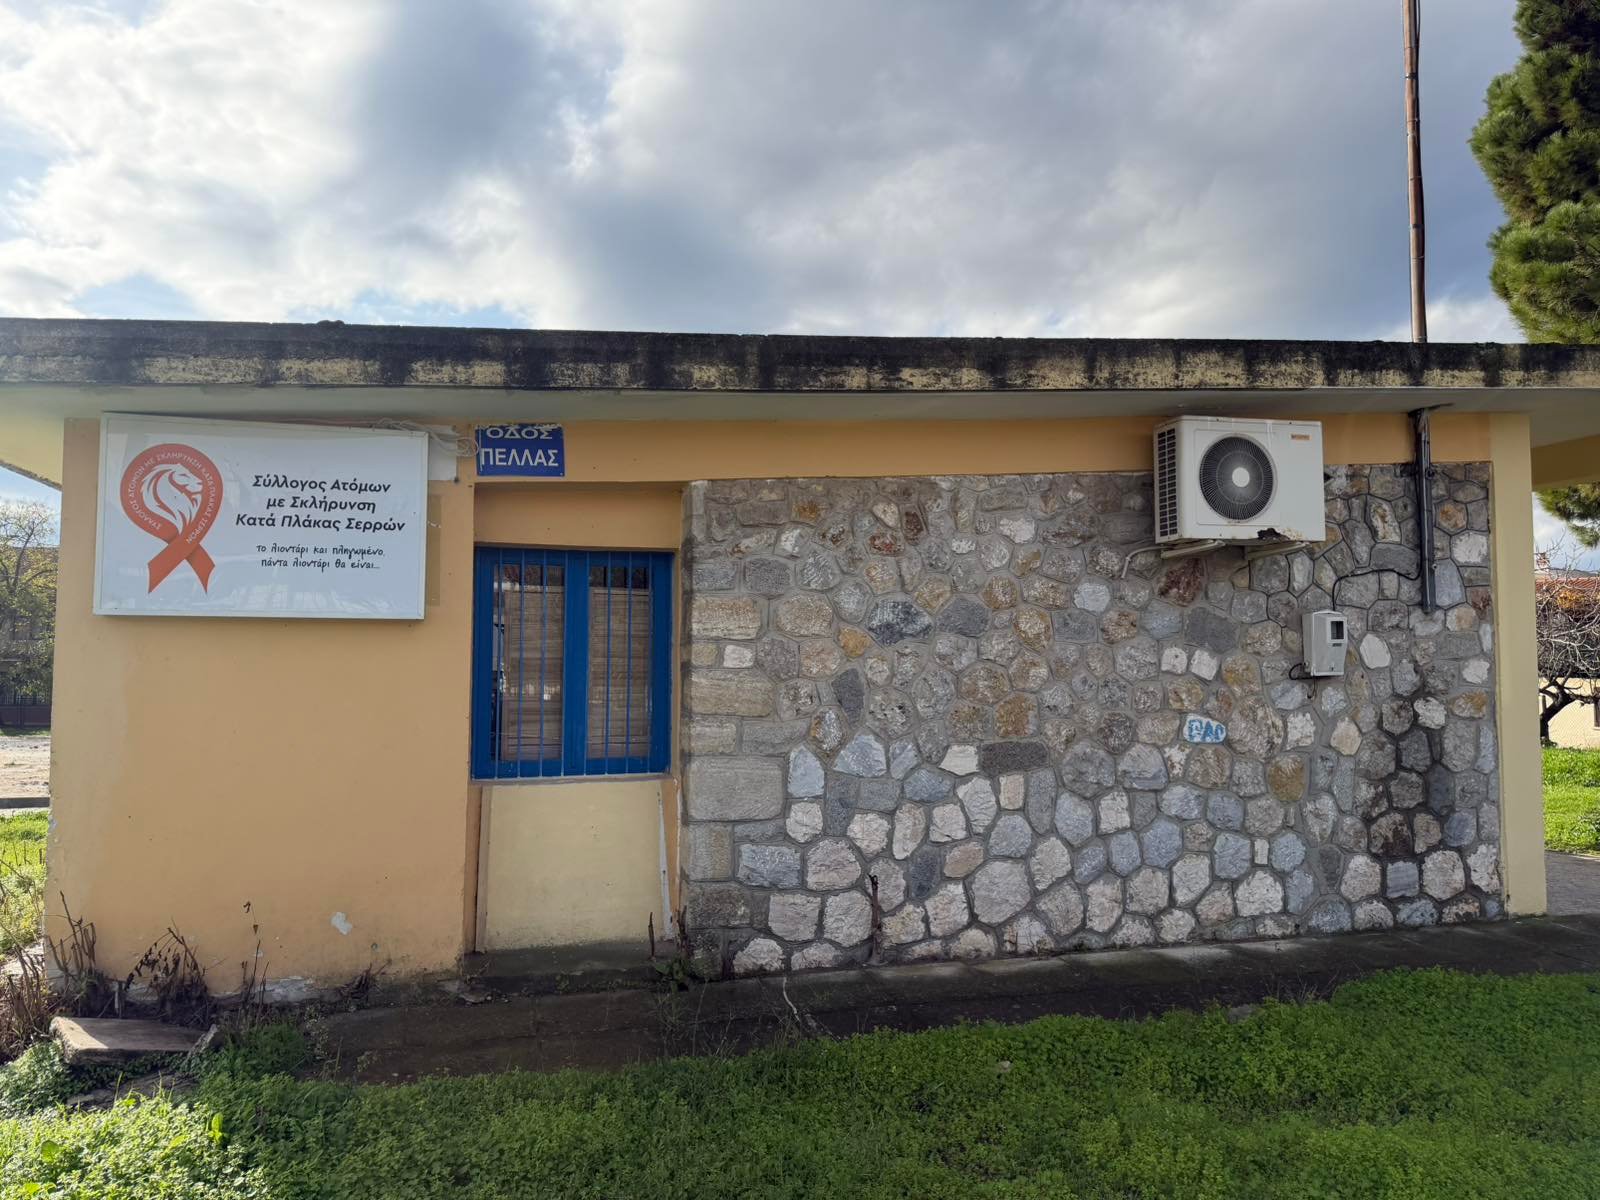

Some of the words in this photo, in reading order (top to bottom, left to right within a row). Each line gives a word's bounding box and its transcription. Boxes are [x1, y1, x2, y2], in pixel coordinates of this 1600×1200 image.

[486, 426, 553, 439] ΟΔΟΣ
[481, 448, 559, 467] ΠΕΛΛΑΣ
[252, 474, 327, 493] Σύλλογος
[330, 478, 391, 494] Ατόμων
[266, 496, 286, 510] με
[290, 496, 376, 514] Σκλήρυνση
[235, 513, 276, 527] Κατά
[281, 514, 341, 531] Πλάκας
[345, 517, 405, 533] Σερρών
[256, 545, 267, 553] το
[271, 543, 309, 558] λιοντάρι
[313, 545, 327, 554] και
[261, 557, 288, 567] πάντα
[292, 557, 330, 573] λιοντάρι
[335, 558, 346, 568] θα
